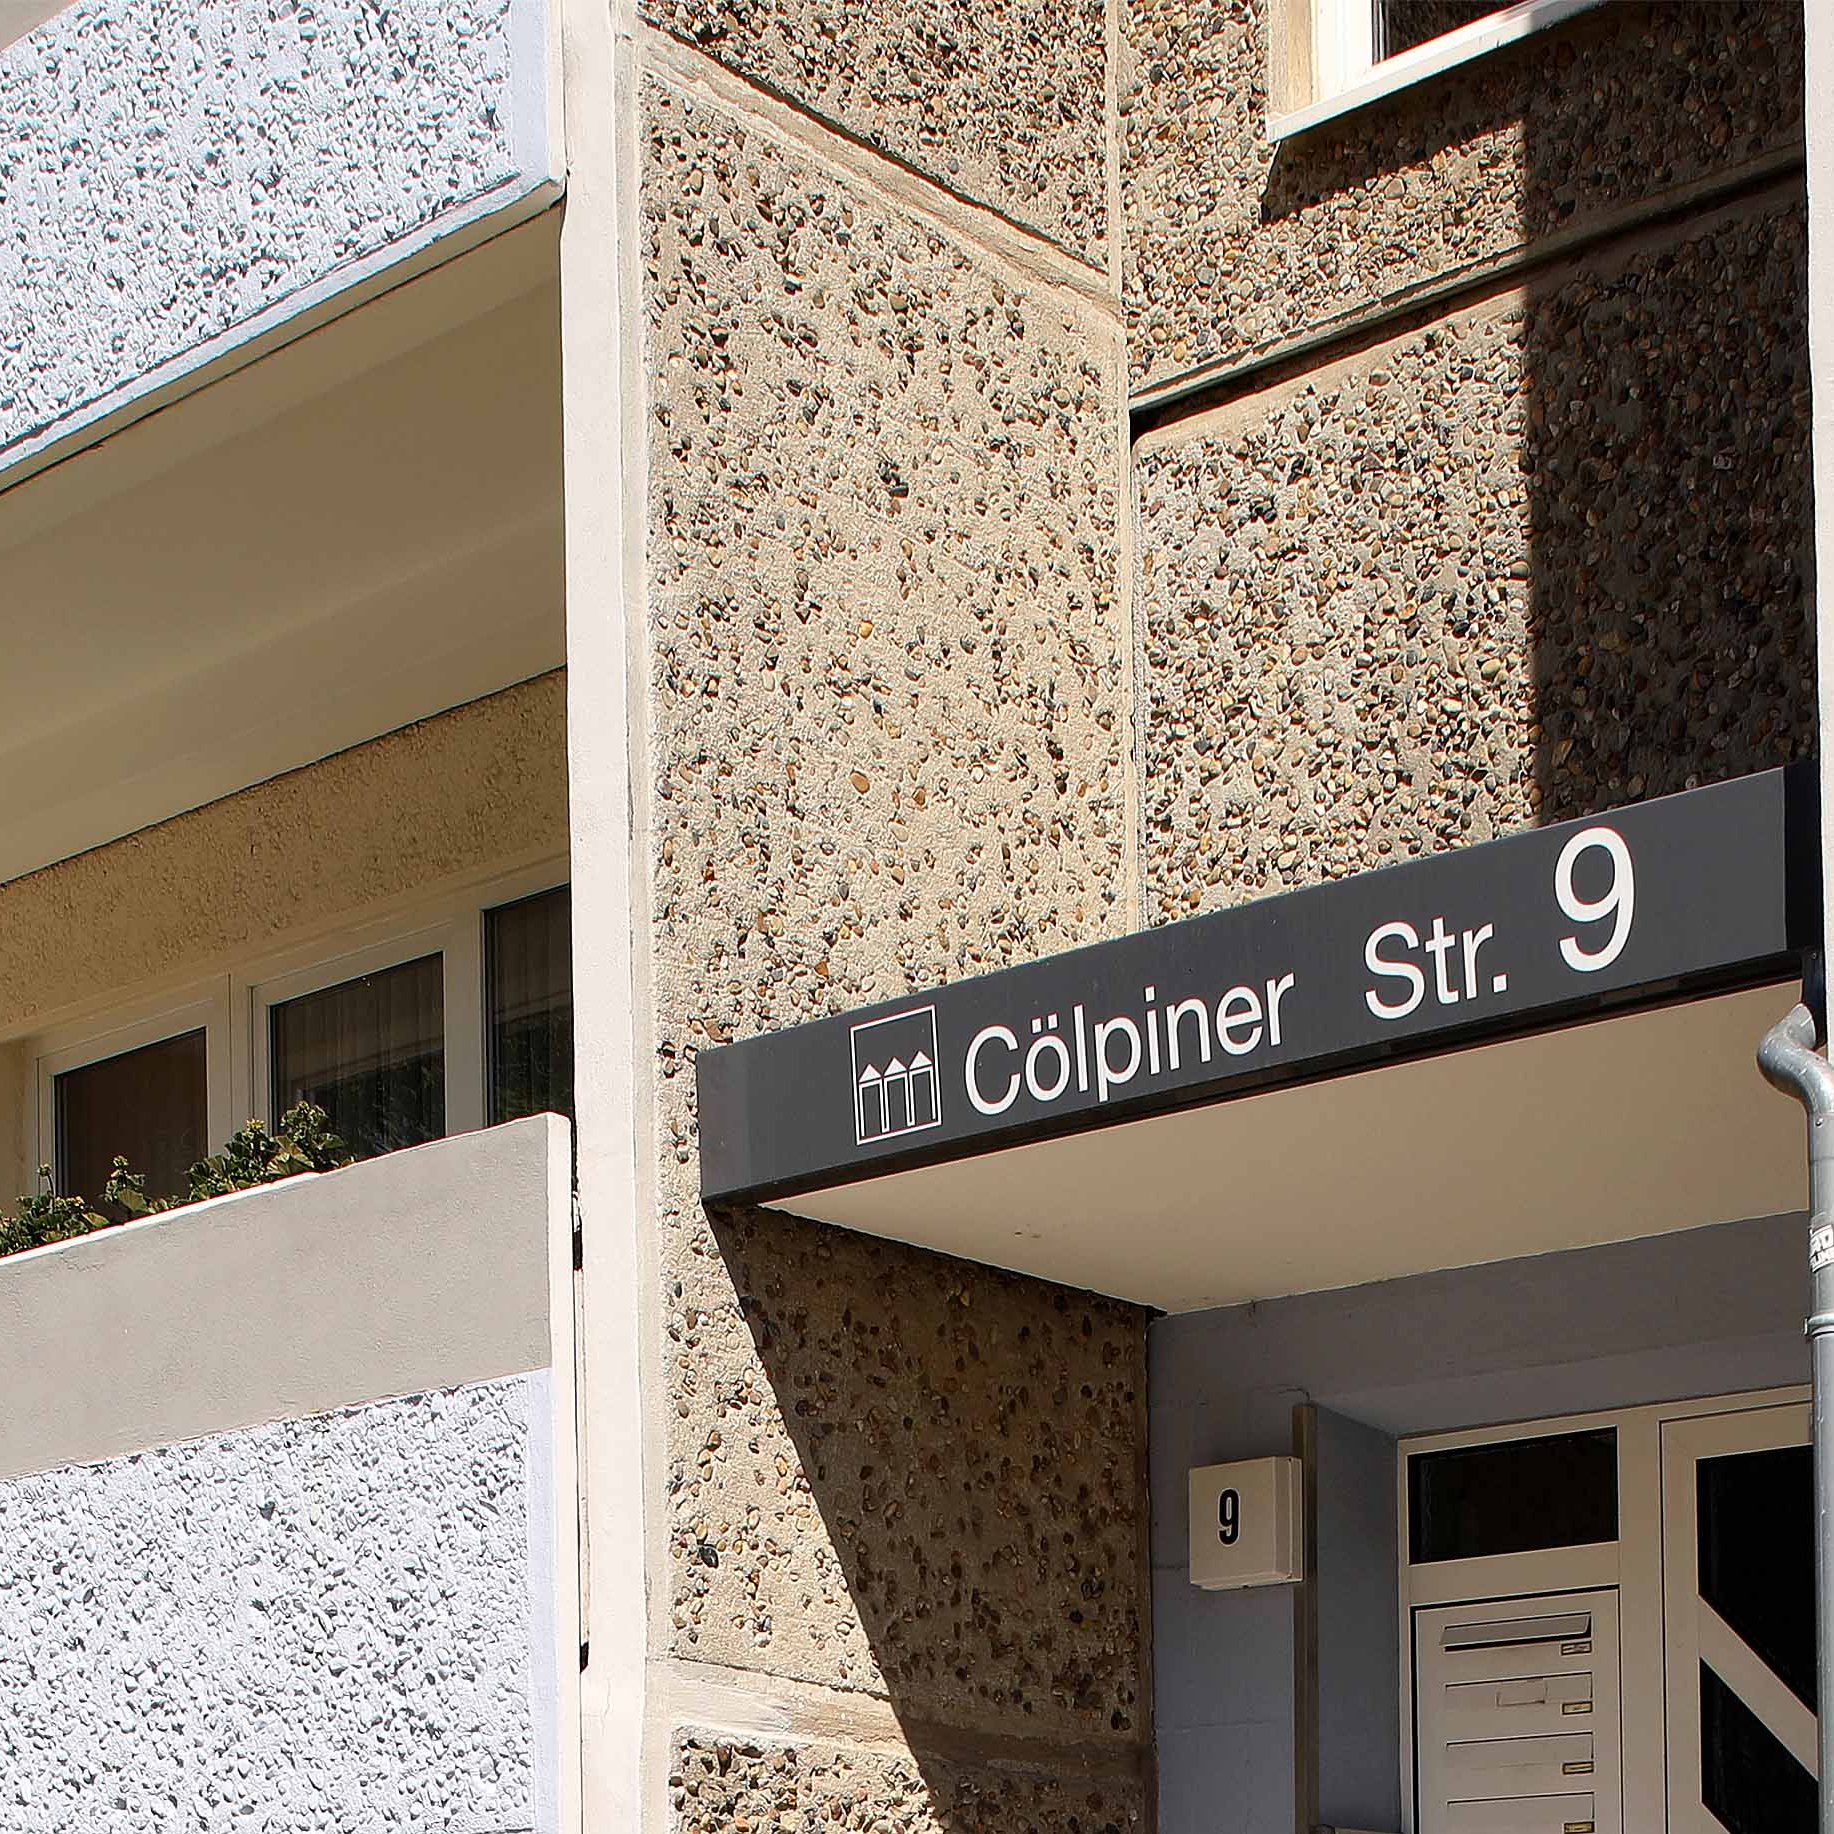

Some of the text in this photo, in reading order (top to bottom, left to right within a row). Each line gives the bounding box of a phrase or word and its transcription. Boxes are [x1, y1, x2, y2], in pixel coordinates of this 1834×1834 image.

[965, 826, 1635, 1115] Cölpiner Str. 9
[1218, 1488, 1240, 1546] 9
